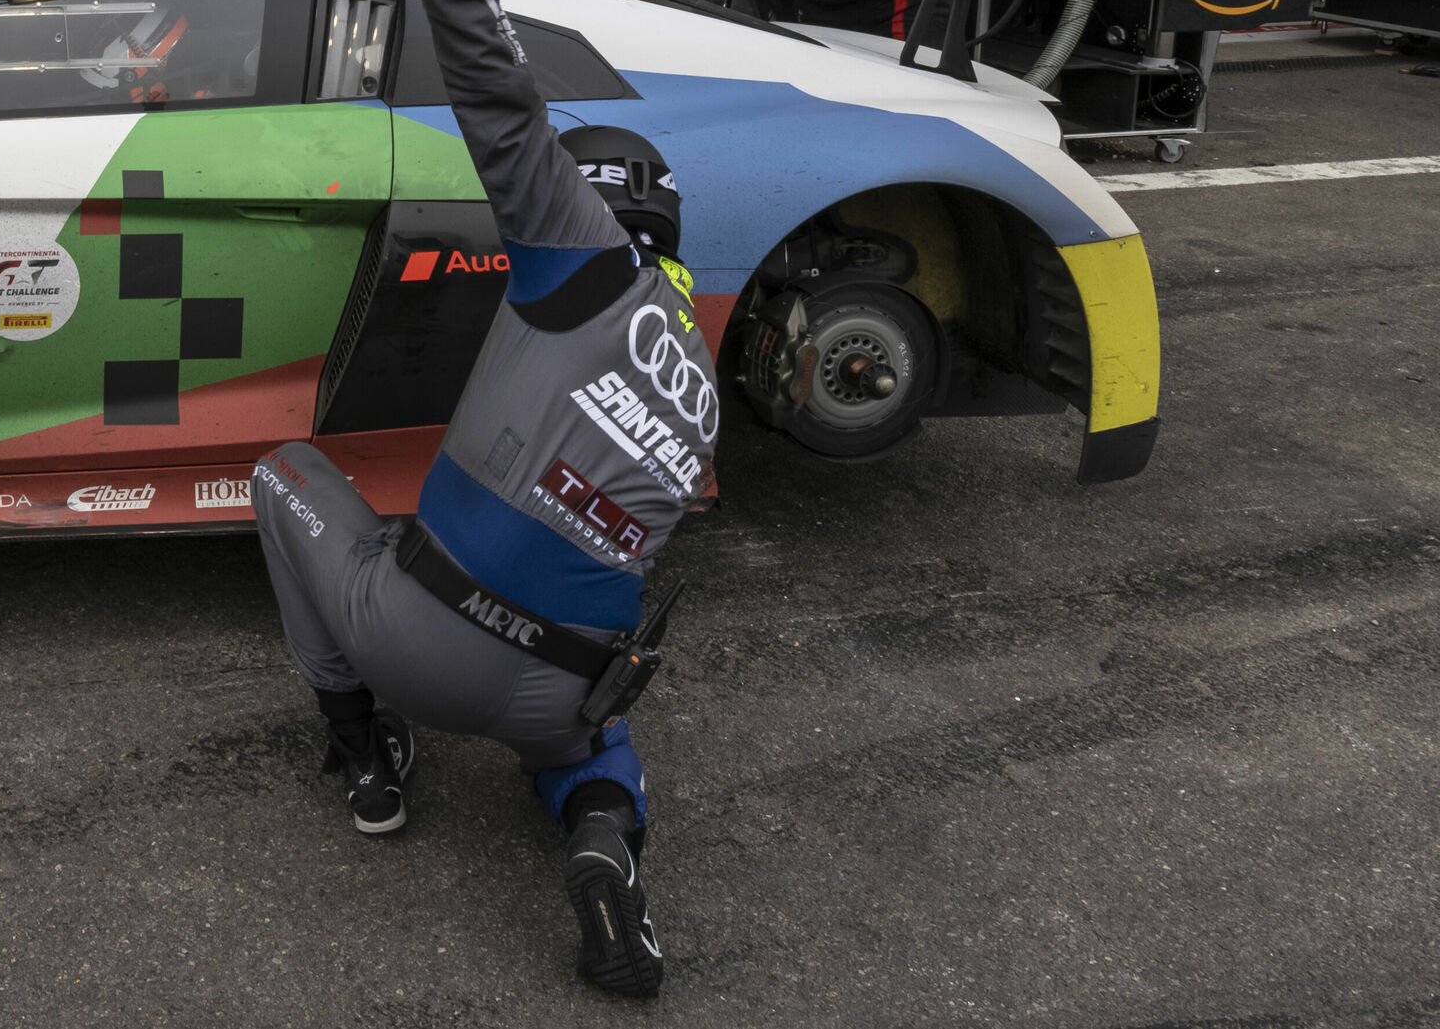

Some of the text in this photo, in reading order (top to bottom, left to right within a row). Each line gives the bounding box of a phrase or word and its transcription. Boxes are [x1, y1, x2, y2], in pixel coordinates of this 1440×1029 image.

[445, 250, 510, 273] Aud
[6, 287, 60, 296] CHALLENGE
[4, 316, 48, 327] PIRELLI
[586, 371, 701, 494] SAINTéLOC
[68, 483, 156, 508] Eibach
[197, 478, 250, 501] HÖR
[286, 494, 325, 537] racing
[560, 469, 644, 550] TLA
[459, 591, 545, 648] MRTC
